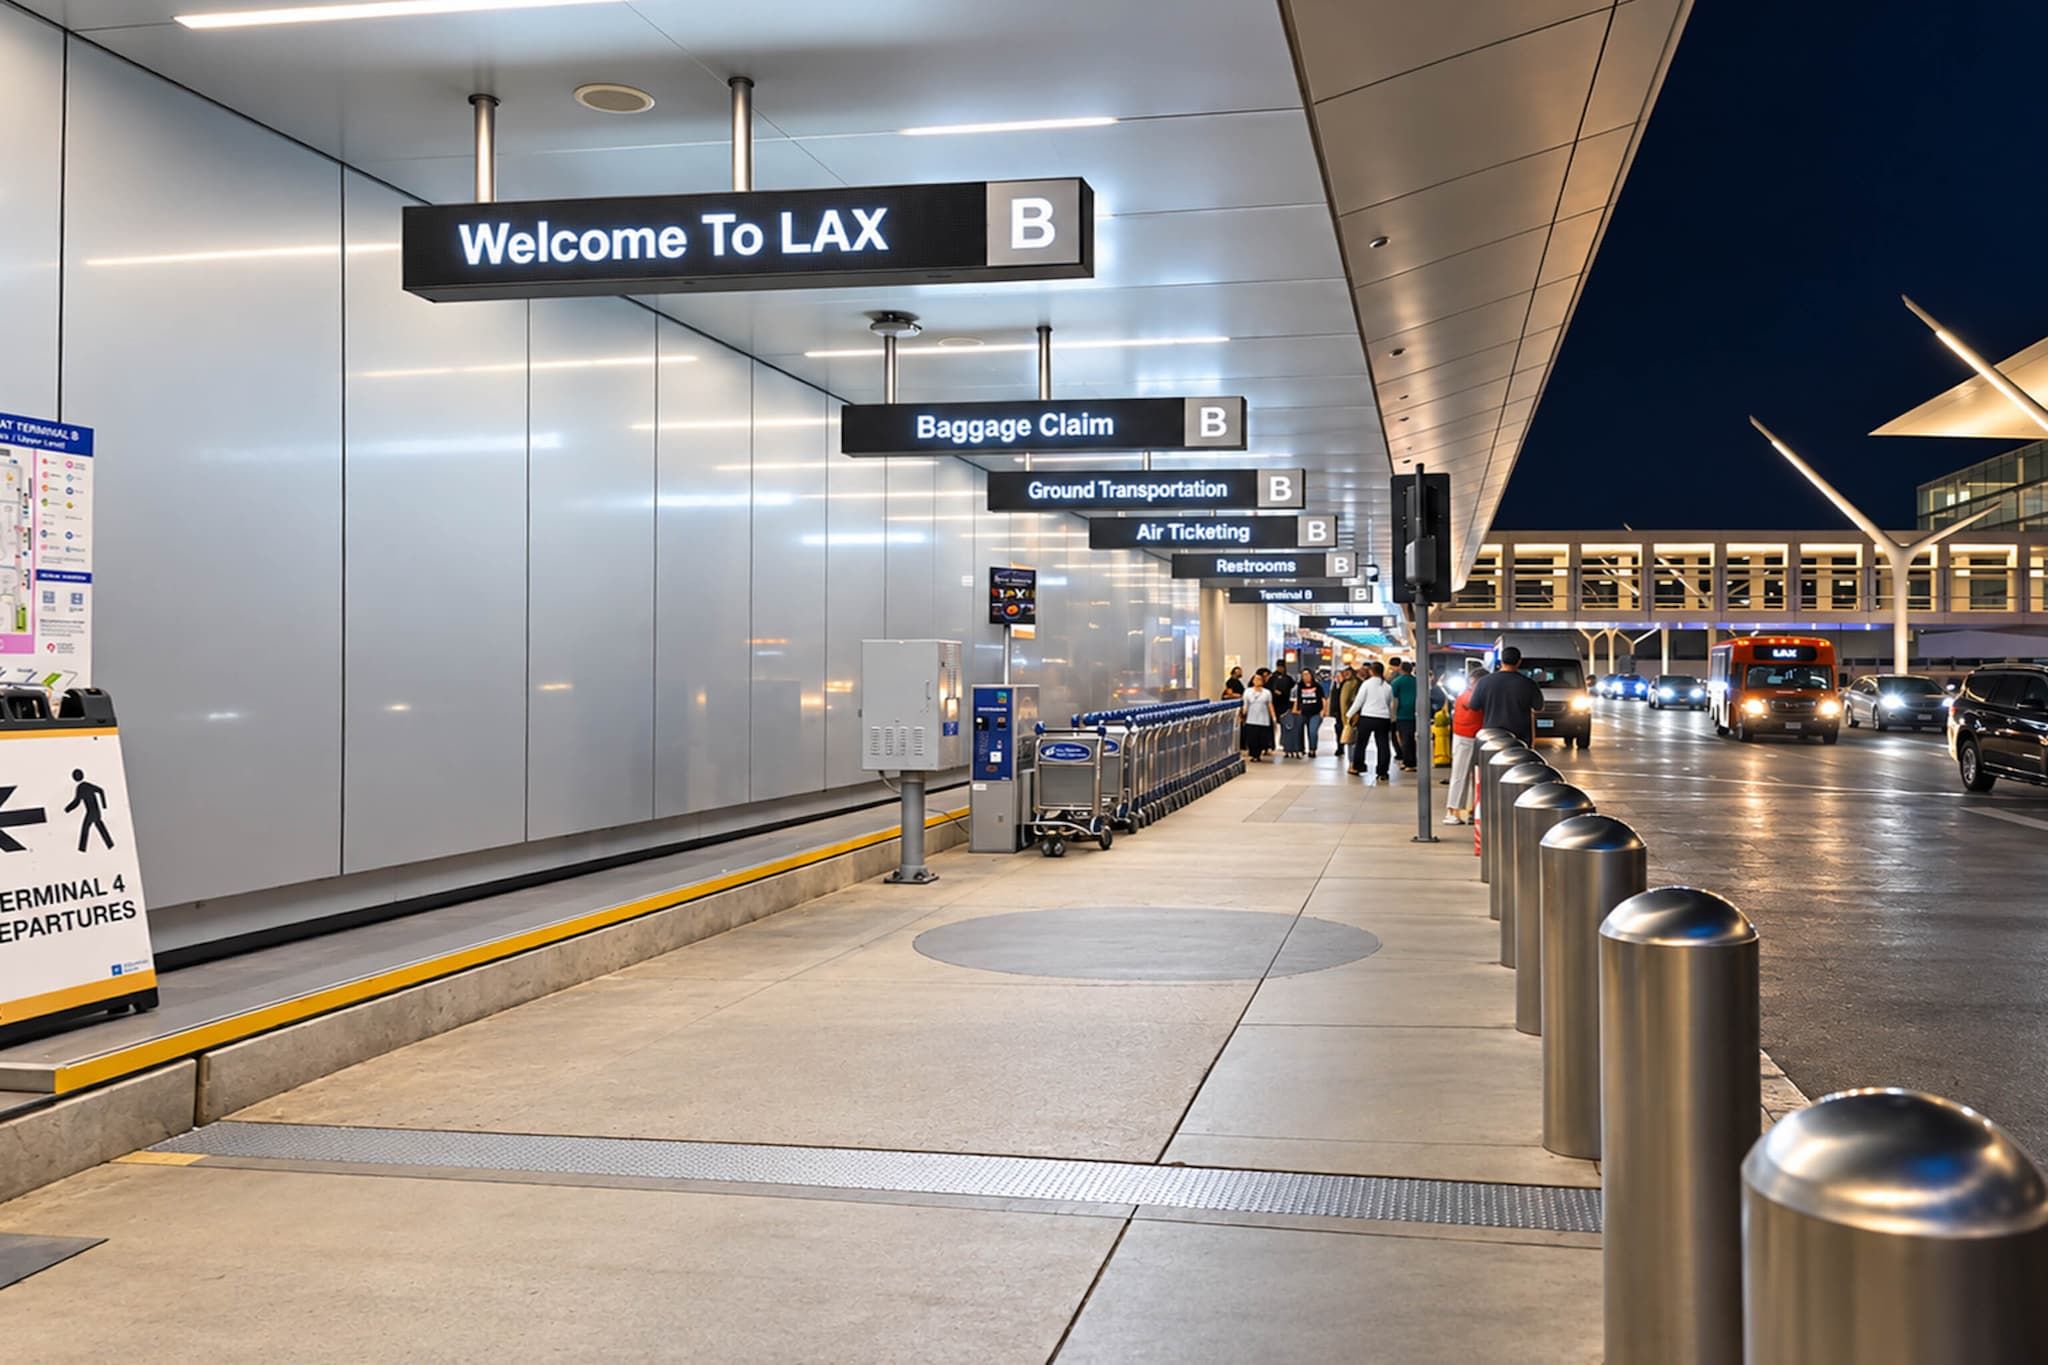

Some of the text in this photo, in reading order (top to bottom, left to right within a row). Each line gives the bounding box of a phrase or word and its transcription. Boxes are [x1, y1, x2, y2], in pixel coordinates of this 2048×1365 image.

[1011, 198, 1055, 249] B
[458, 207, 888, 265] Welcome To LAX
[916, 412, 1114, 443] Baggage Claim
[1199, 407, 1227, 437] B
[1028, 479, 1228, 501] Ground Transportation
[1269, 476, 1292, 501] B
[1136, 522, 1250, 542] Air Ticketing
[1307, 521, 1327, 542] B
[1216, 558, 1297, 573] Restrooms
[1334, 557, 1349, 574] B
[1259, 589, 1303, 600] Terminal
[1354, 588, 1368, 601] B
[1772, 648, 1798, 658] LAX
[0, 873, 125, 913] ERMINAL 4
[0, 900, 136, 944] EPARTURES
